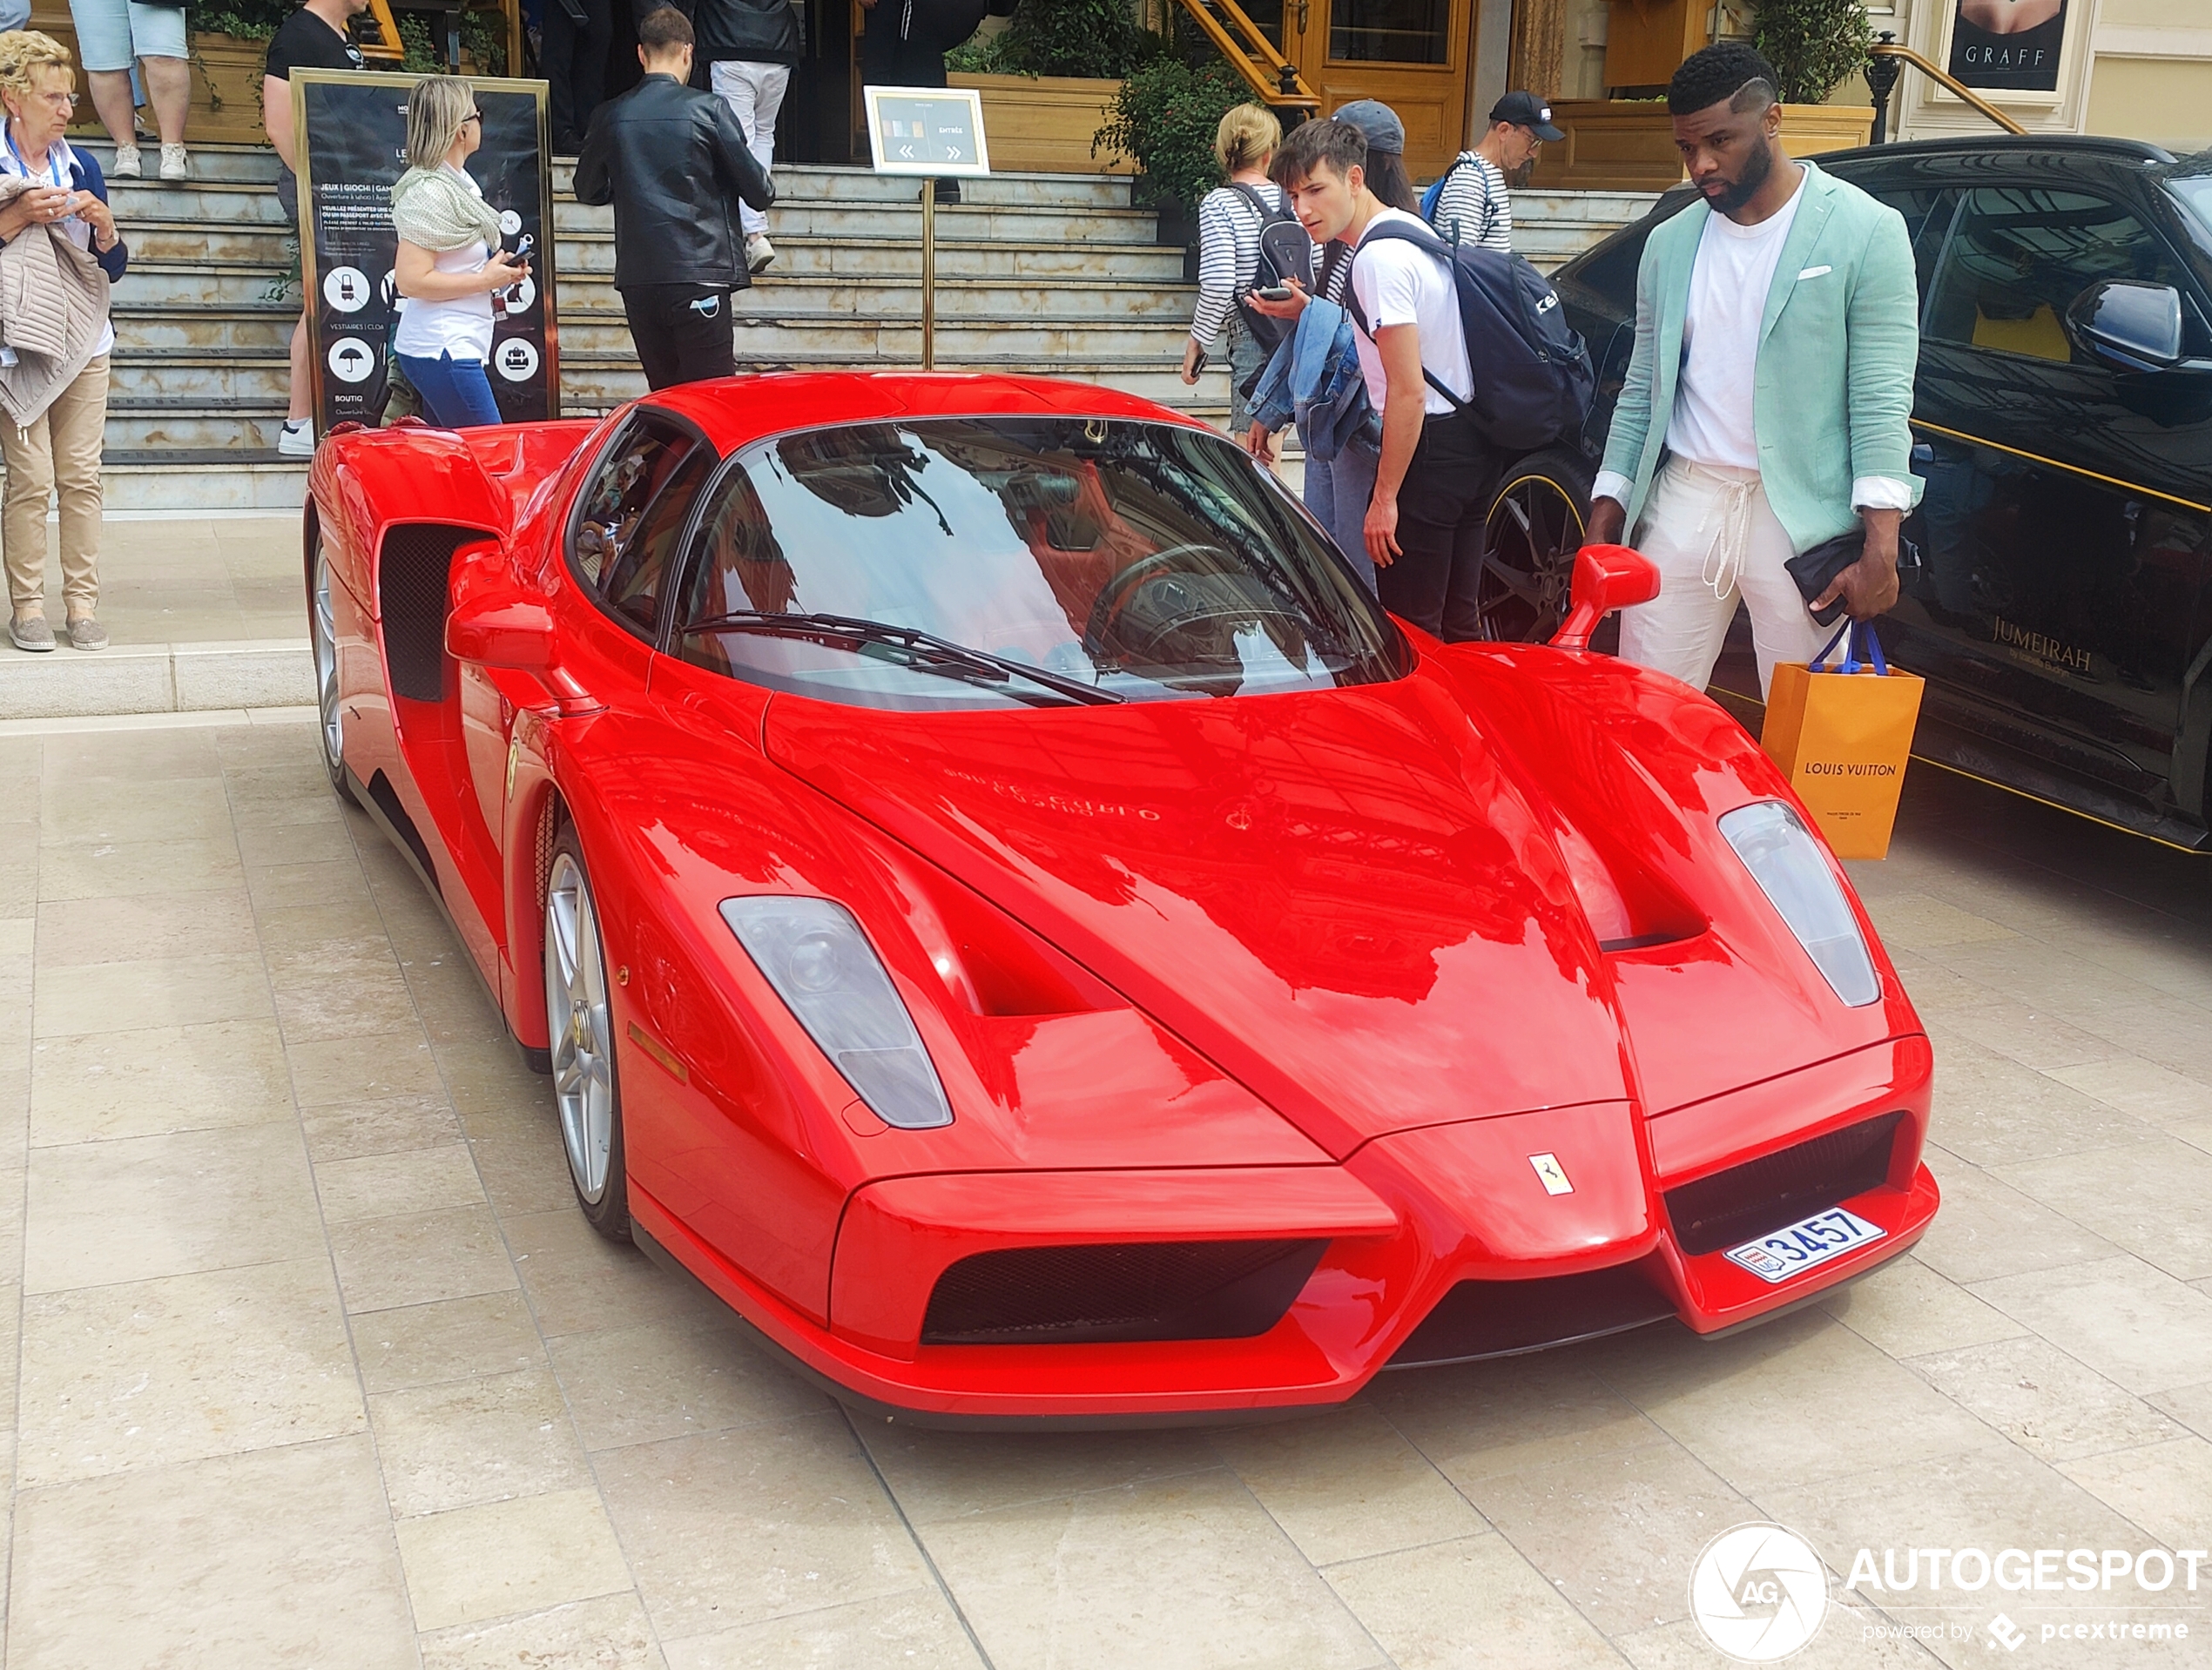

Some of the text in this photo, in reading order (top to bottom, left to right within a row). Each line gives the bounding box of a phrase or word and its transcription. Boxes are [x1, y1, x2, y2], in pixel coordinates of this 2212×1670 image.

[1965, 45, 2045, 66] GRAFF
[939, 125, 963, 134] ENTRÉE
[1993, 615, 2091, 672] JUMEIRAH
[2009, 647, 2019, 660] by
[1804, 762, 1897, 777] LOUIS VUITTON
[1765, 1211, 1863, 1262] 3457
